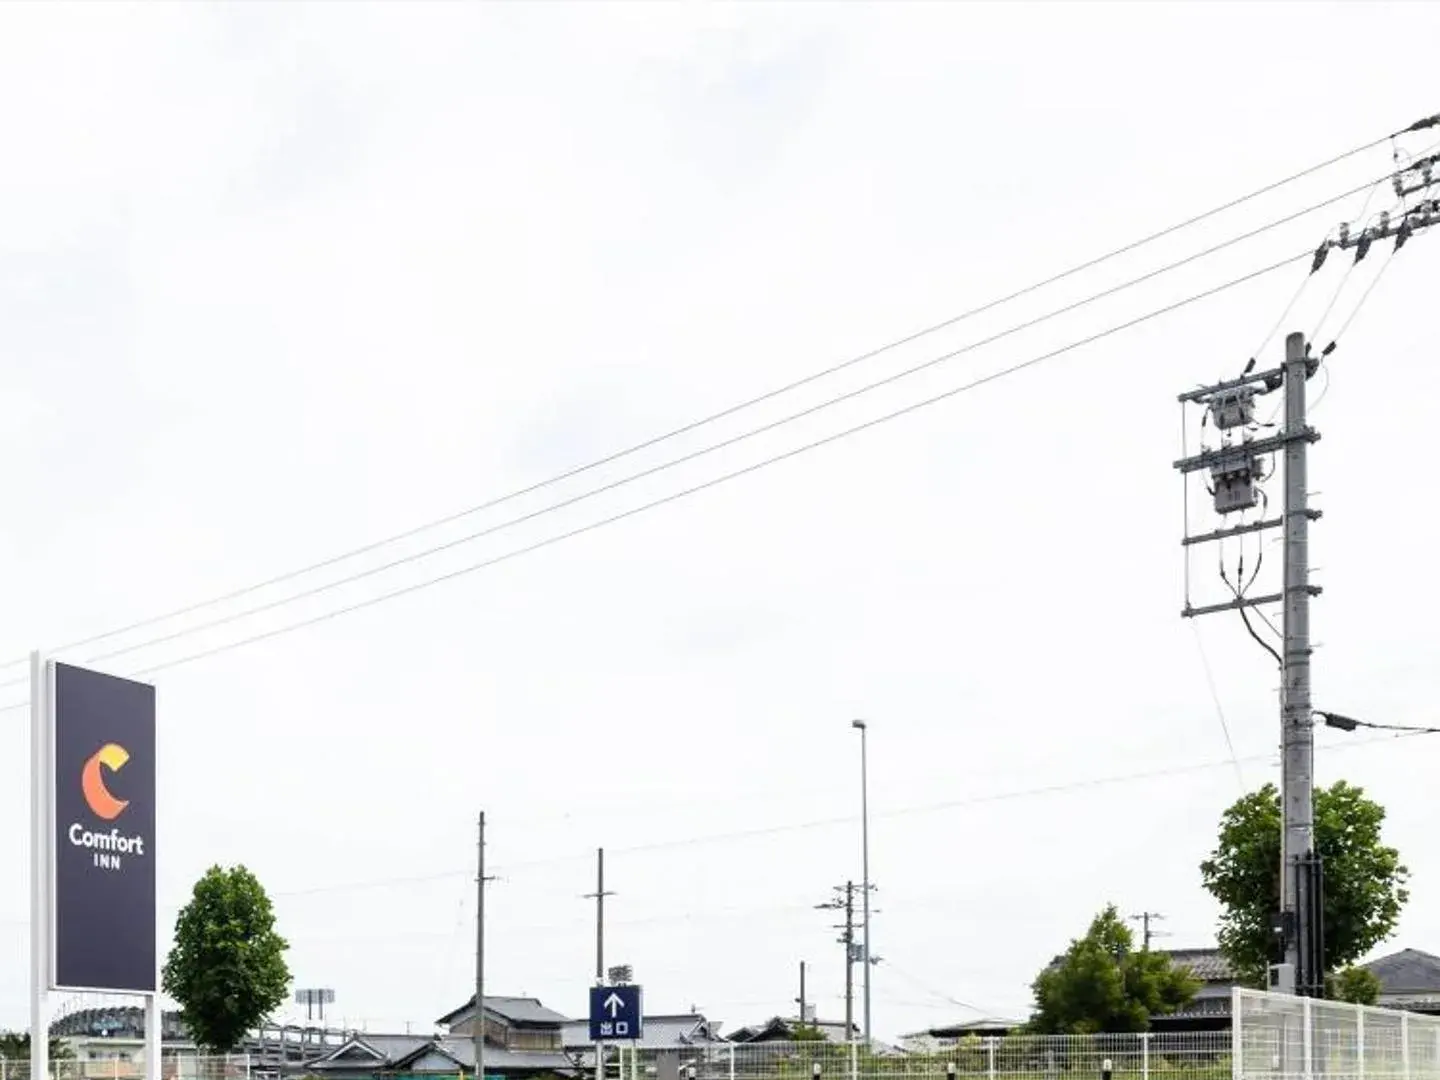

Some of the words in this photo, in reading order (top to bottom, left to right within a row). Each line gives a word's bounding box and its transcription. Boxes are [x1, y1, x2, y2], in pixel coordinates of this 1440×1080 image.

[68, 822, 144, 855] Comfort
[93, 852, 120, 870] INN
[600, 1021, 628, 1036] 出口
